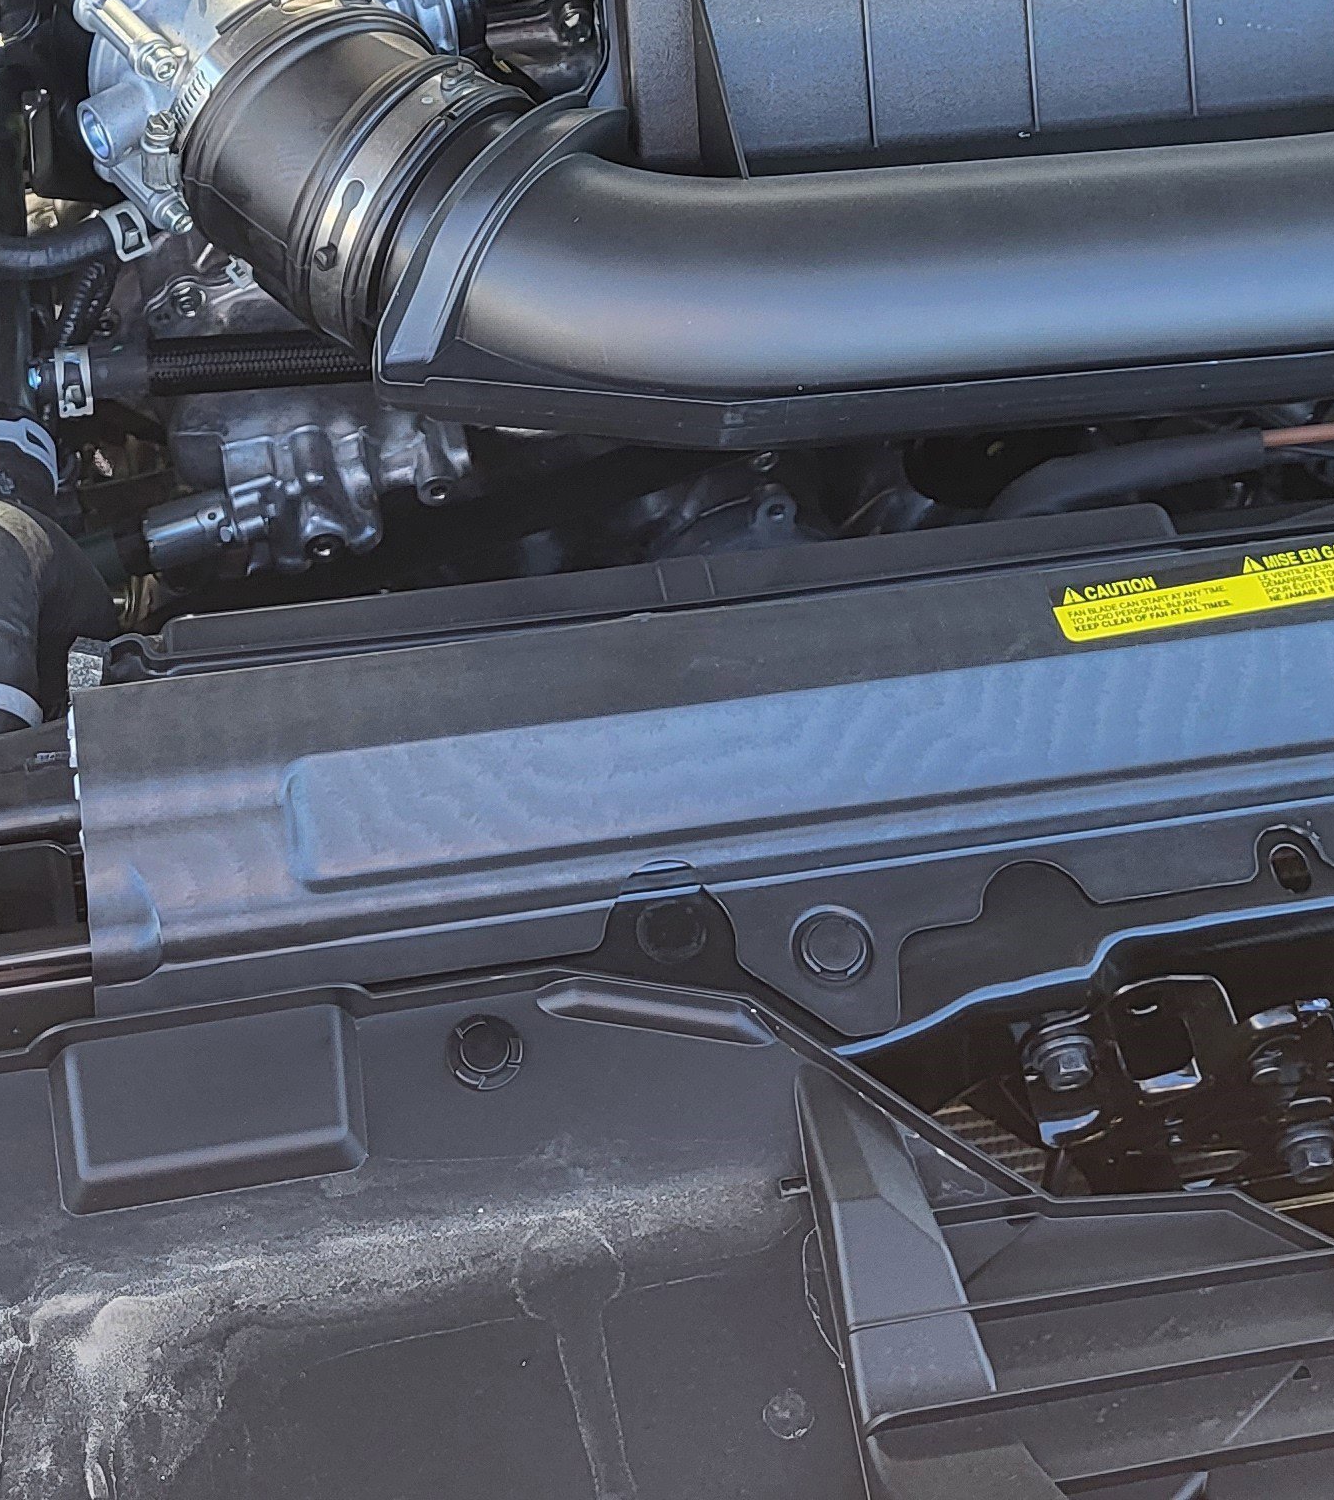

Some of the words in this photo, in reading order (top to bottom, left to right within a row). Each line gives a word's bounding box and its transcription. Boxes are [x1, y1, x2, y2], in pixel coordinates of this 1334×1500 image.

[1261, 552, 1300, 570] MISE
[1299, 547, 1321, 563] EN
[1271, 563, 1333, 579] VENTILATEUR
[1084, 577, 1157, 600] CAUTION
[1067, 609, 1087, 619] FAN
[1088, 604, 1119, 616] BLADE
[1119, 601, 1140, 611] CAN
[1141, 595, 1171, 607] START
[1170, 592, 1182, 602] AT
[1182, 589, 1203, 600] ANY
[1071, 617, 1086, 626] TO
[1085, 612, 1115, 624] AVOID
[1114, 605, 1164, 620] PERSONAL
[1074, 622, 1100, 633] KEEP
[1100, 617, 1134, 629] CLEAR
[1134, 613, 1148, 623] OF
[1148, 610, 1169, 621] FAN
[1170, 607, 1183, 617] AT
[1183, 604, 1203, 615] ALL
